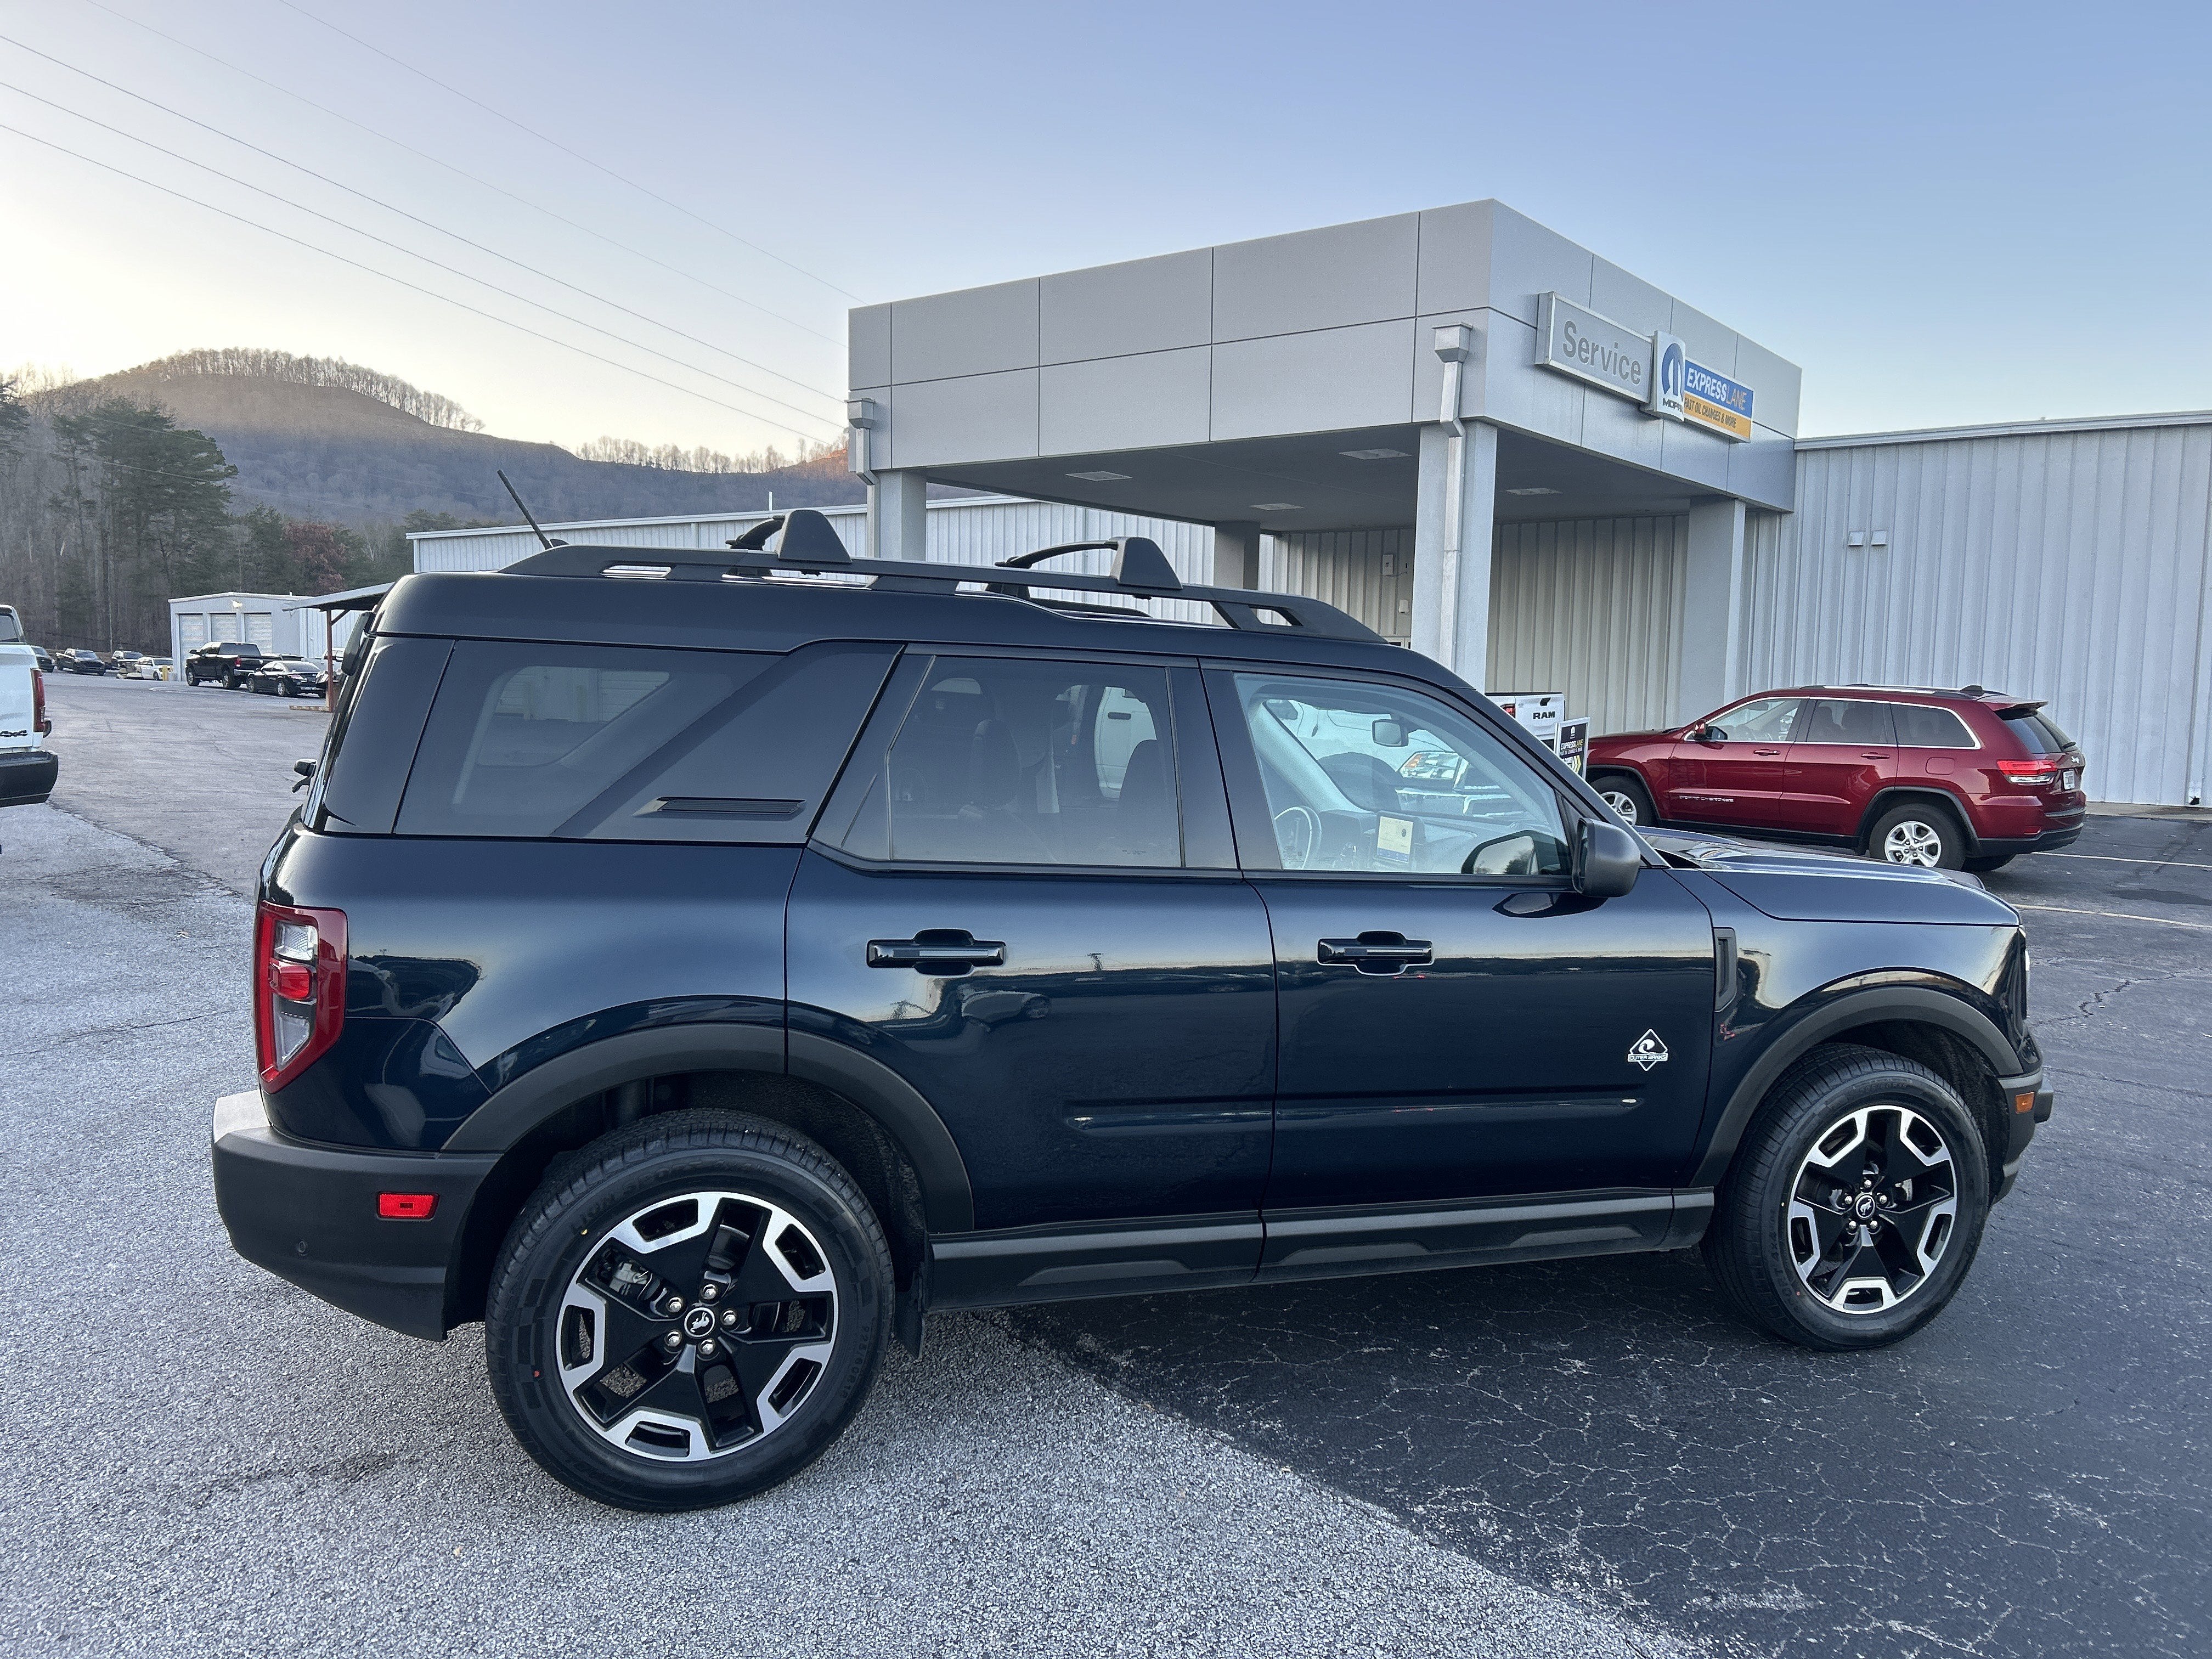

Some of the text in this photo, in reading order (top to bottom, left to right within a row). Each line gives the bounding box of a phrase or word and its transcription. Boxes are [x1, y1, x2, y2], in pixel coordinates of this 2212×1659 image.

[1562, 320, 1641, 386] Service
[1663, 398, 1684, 414] MOPA
[1532, 711, 1555, 720] RAM
